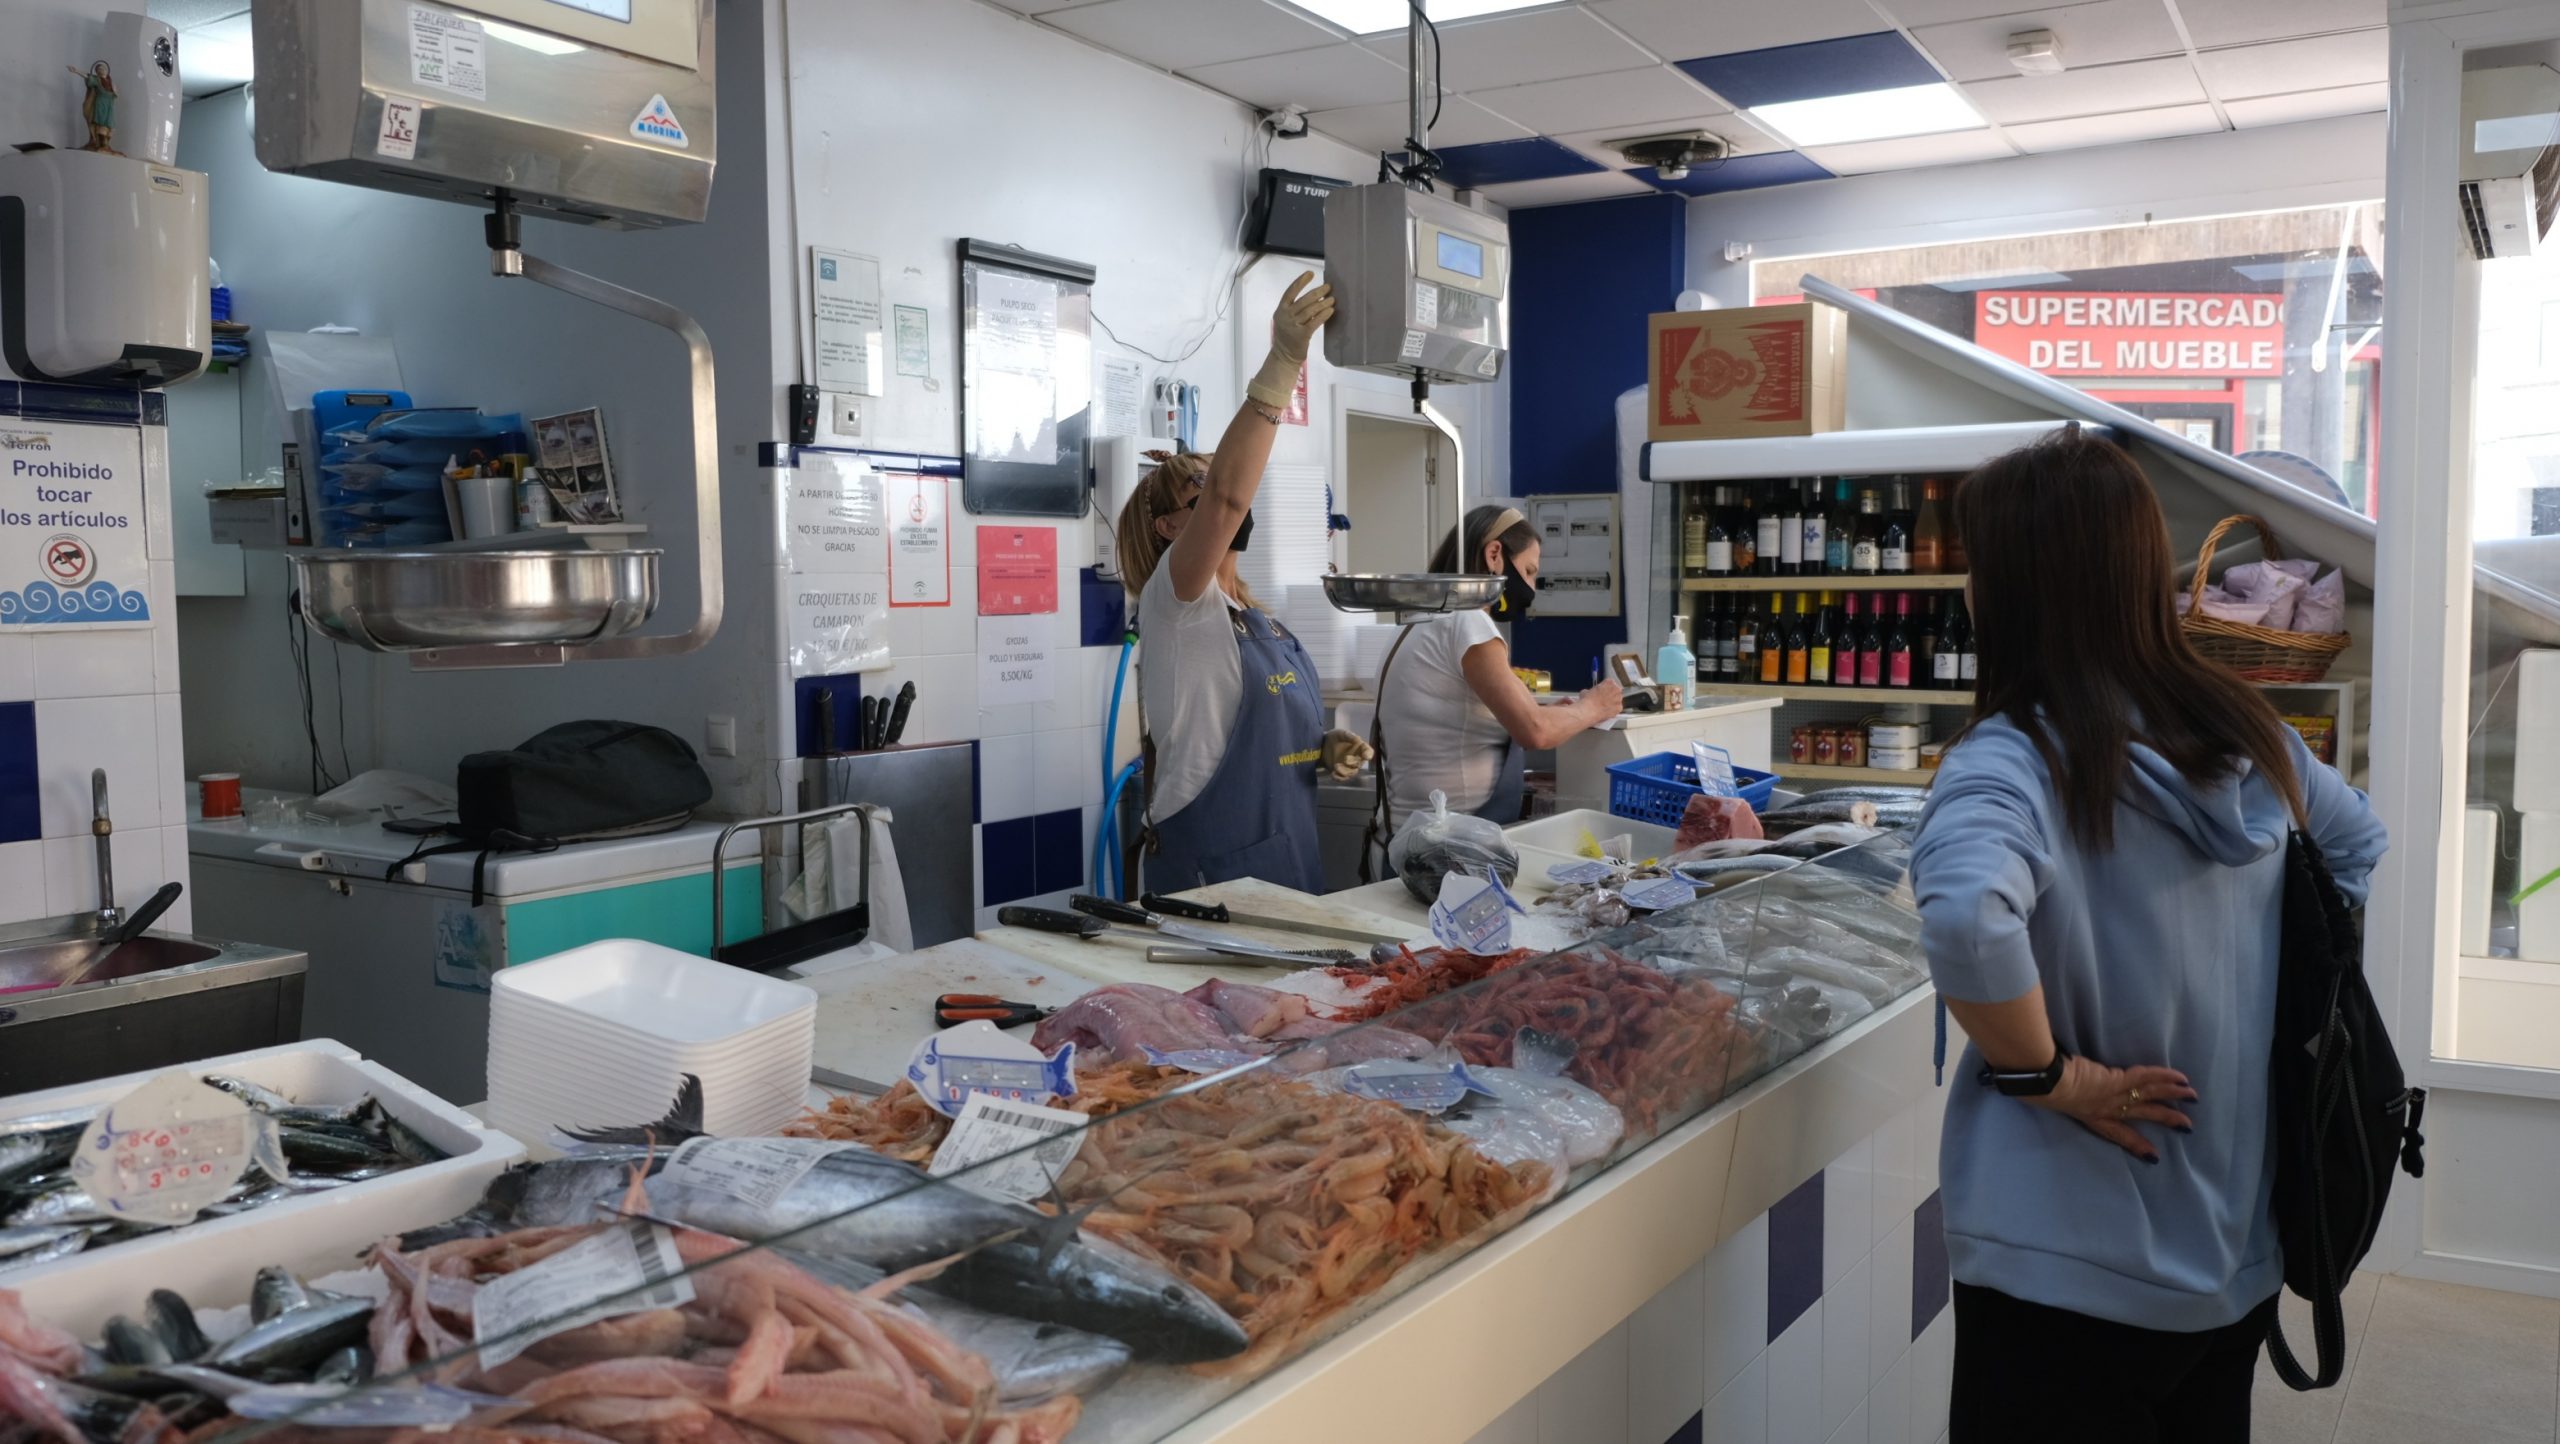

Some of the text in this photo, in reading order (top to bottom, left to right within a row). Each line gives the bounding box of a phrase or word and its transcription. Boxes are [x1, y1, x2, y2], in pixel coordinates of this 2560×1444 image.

[638, 122, 682, 140] MAGRINA
[1286, 183, 1301, 194] SU
[1984, 297, 2285, 327] SUPERMERCAD
[2029, 341, 2274, 371] DEL MUEBLE
[13, 459, 113, 480] Prohibido
[37, 485, 92, 503] tocar
[799, 489, 805, 498] A
[807, 490, 833, 499] PARTIR
[1, 508, 128, 528] los artículos
[798, 525, 880, 537] NO SE LIMPIA PESCADO
[825, 543, 855, 553] GRACIAS
[1857, 546, 1871, 555] 35
[798, 593, 878, 608] CROQUETAS DE
[813, 615, 864, 629] CAMARON
[989, 654, 1008, 663] POLLO
[1014, 652, 1044, 661] VERDURAS
